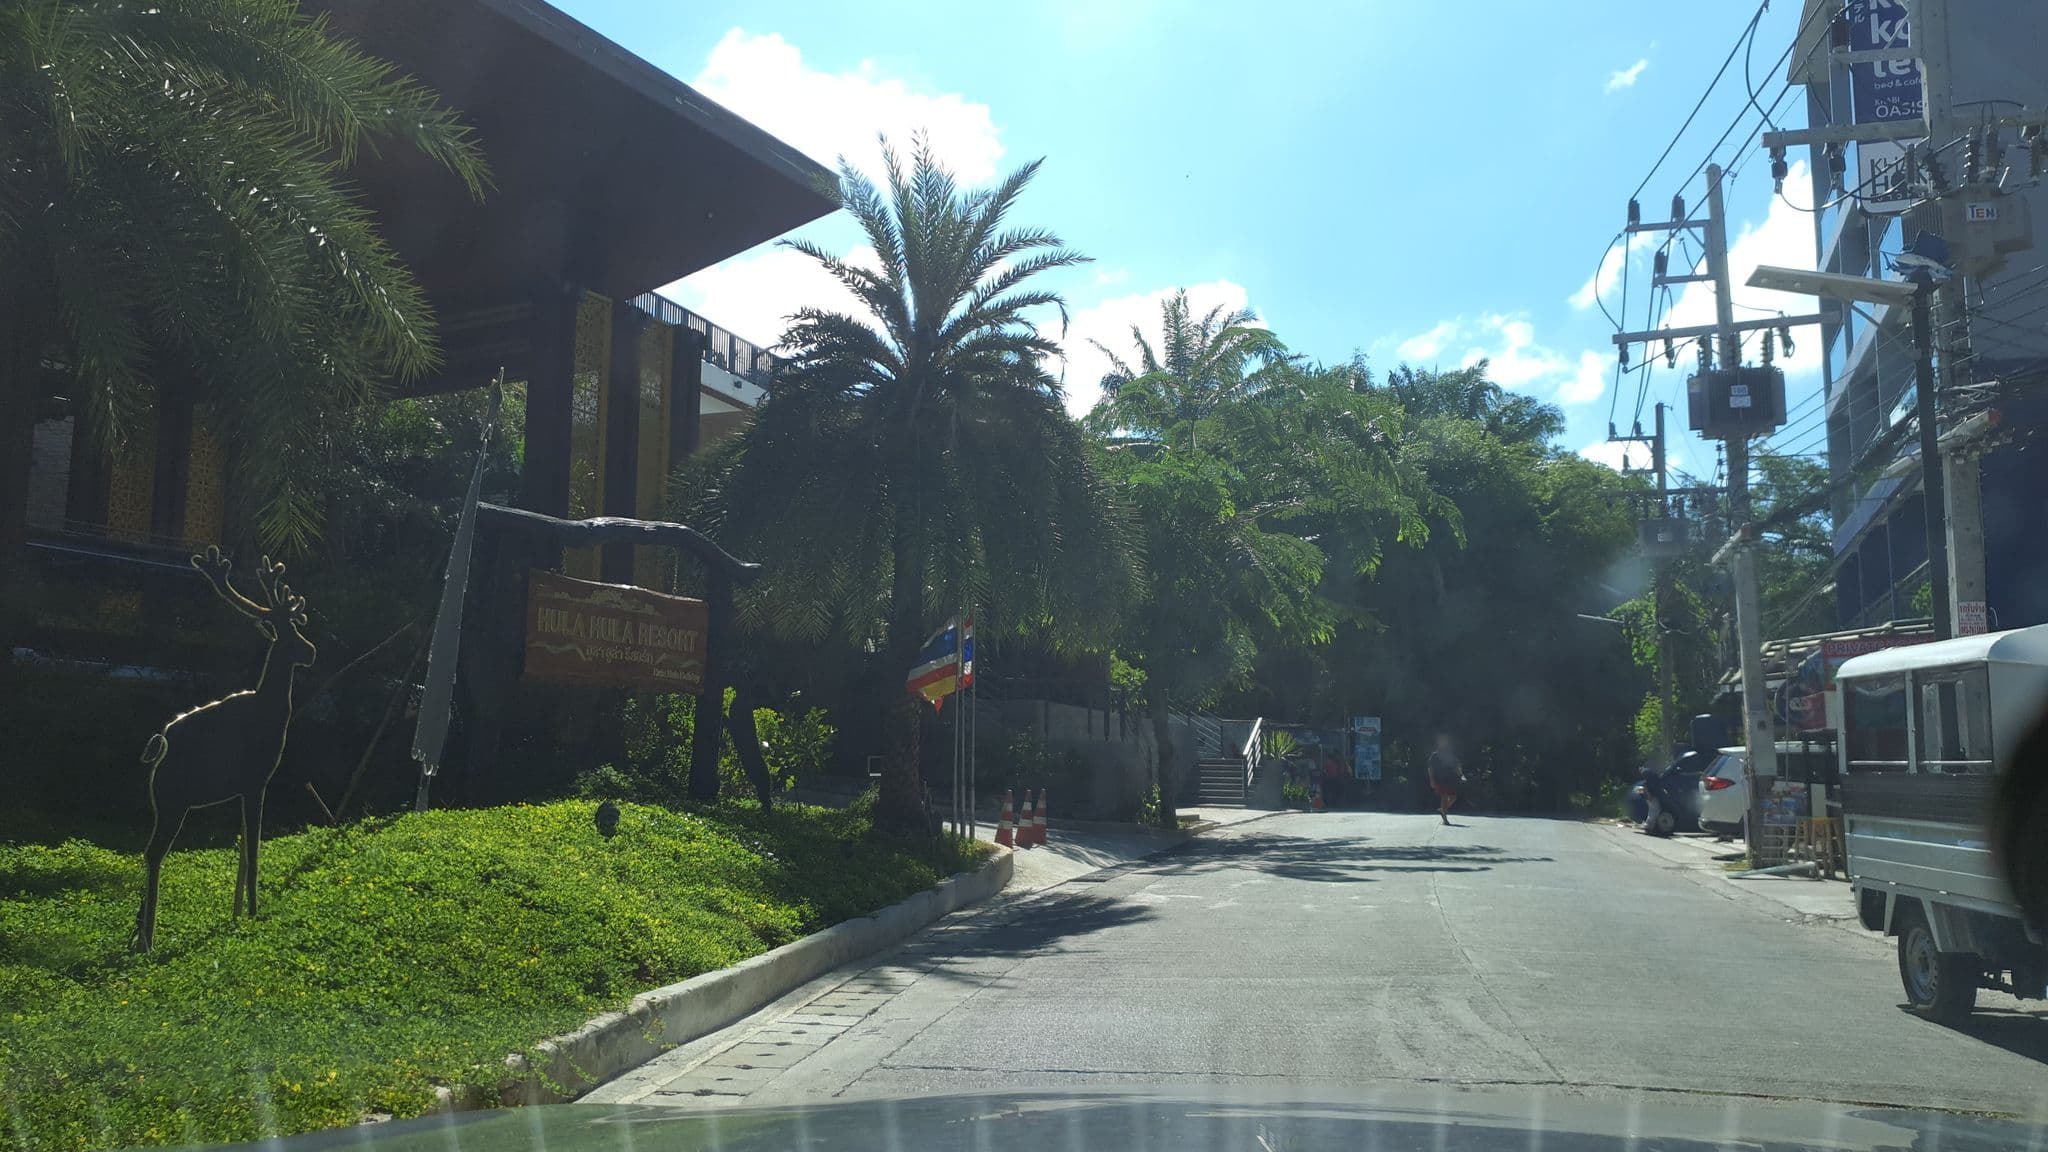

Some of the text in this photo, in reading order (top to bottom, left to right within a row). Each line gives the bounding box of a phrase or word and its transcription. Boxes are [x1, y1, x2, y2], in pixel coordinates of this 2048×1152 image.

[1875, 100, 1924, 118] OASIS
[1968, 204, 1996, 219] TEN
[537, 607, 699, 653] HULA HULA RESORT
